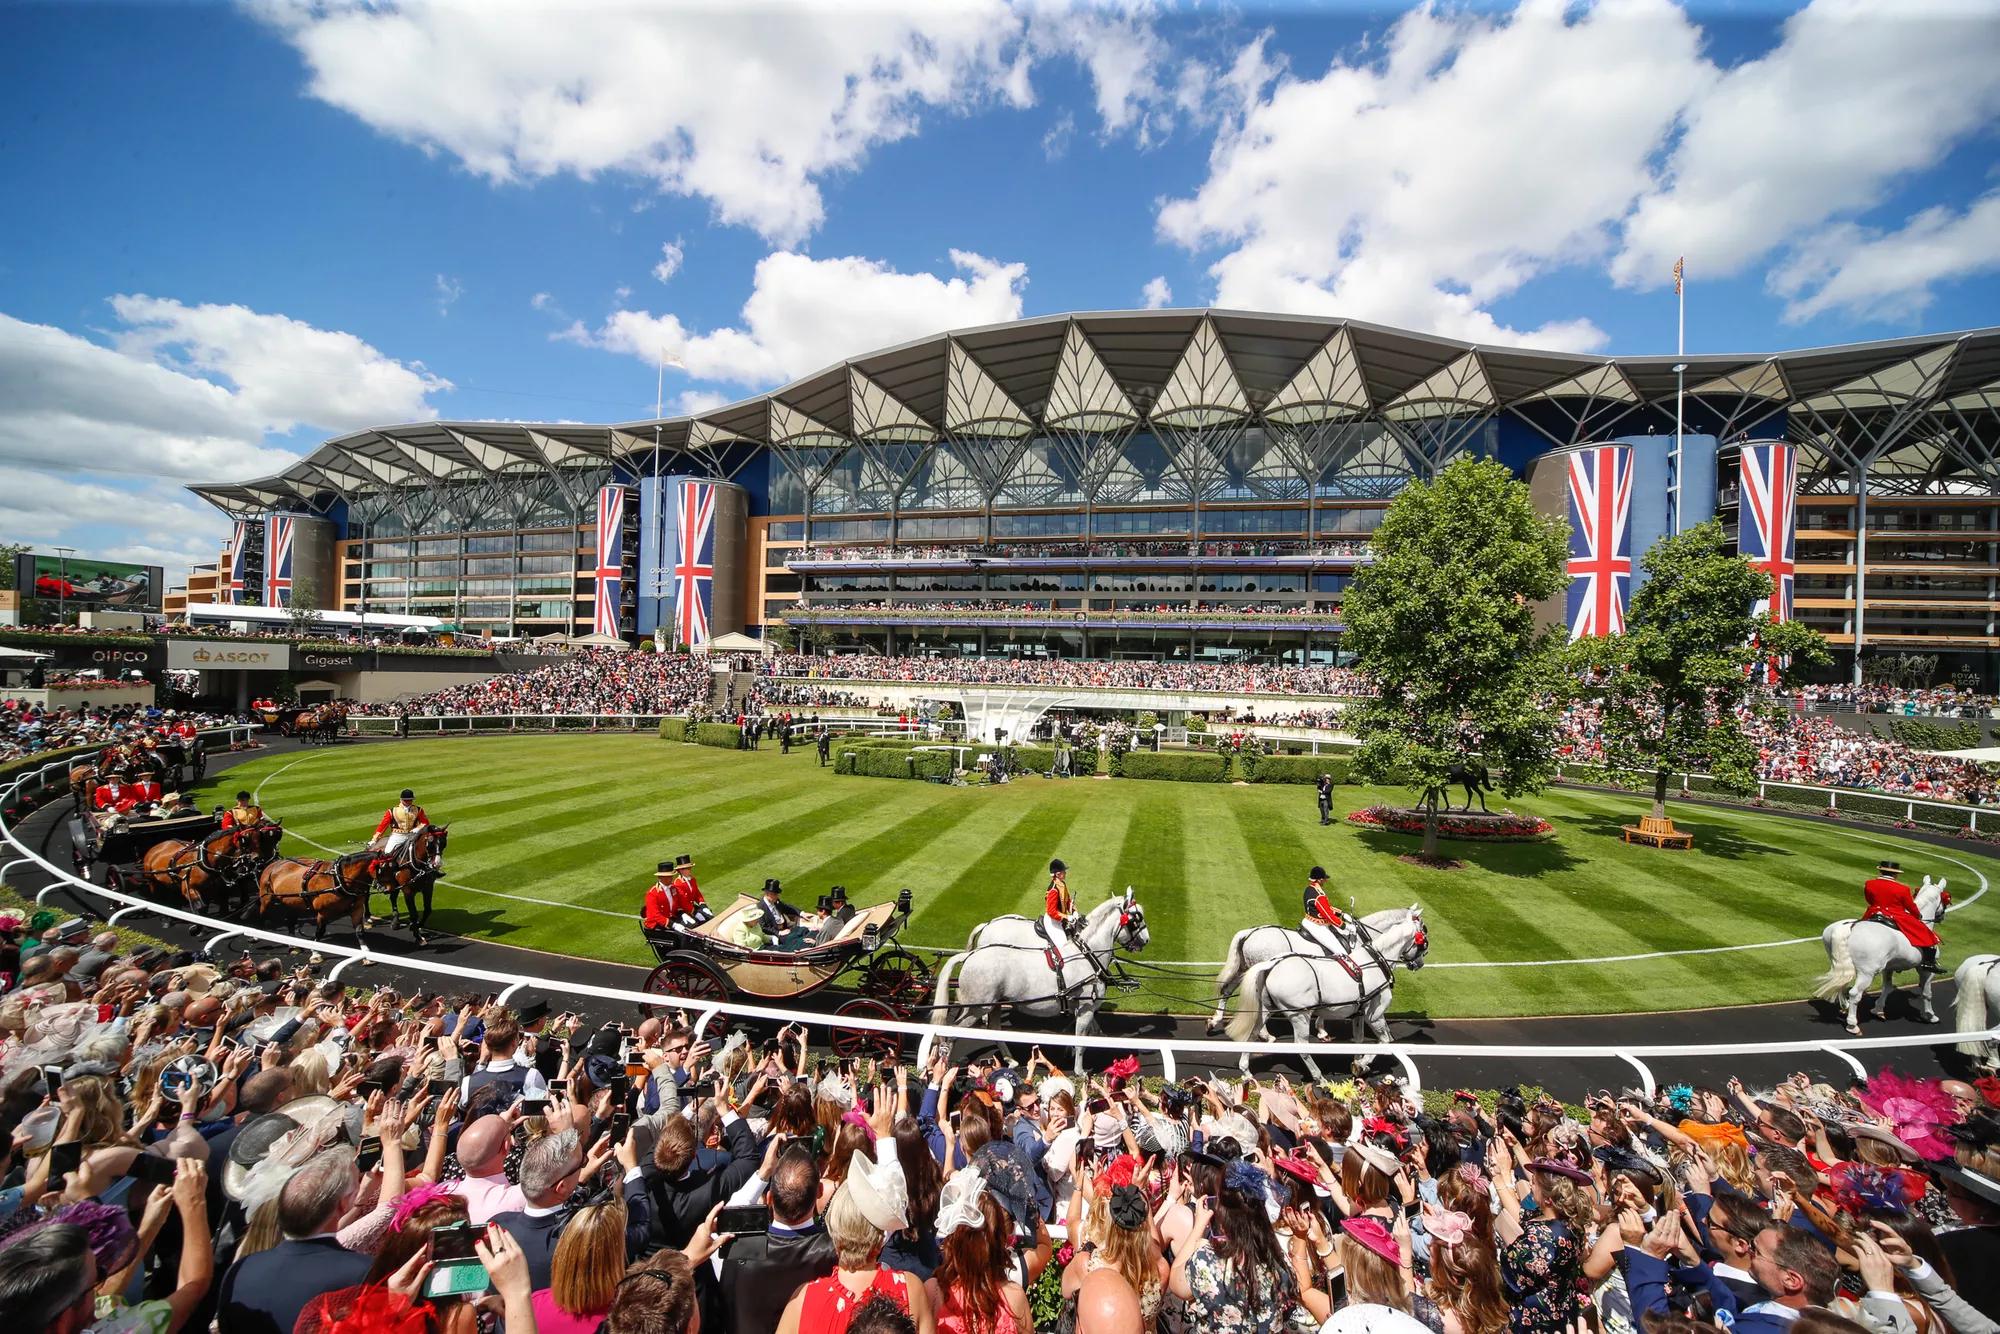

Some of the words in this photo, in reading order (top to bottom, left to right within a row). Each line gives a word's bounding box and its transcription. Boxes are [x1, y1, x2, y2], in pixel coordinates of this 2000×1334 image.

[213, 651, 270, 664] ASCOT
[305, 654, 353, 668] Gigaset
[1951, 672, 1980, 680] ROYAL
[1951, 679, 1980, 687] ASCOT
